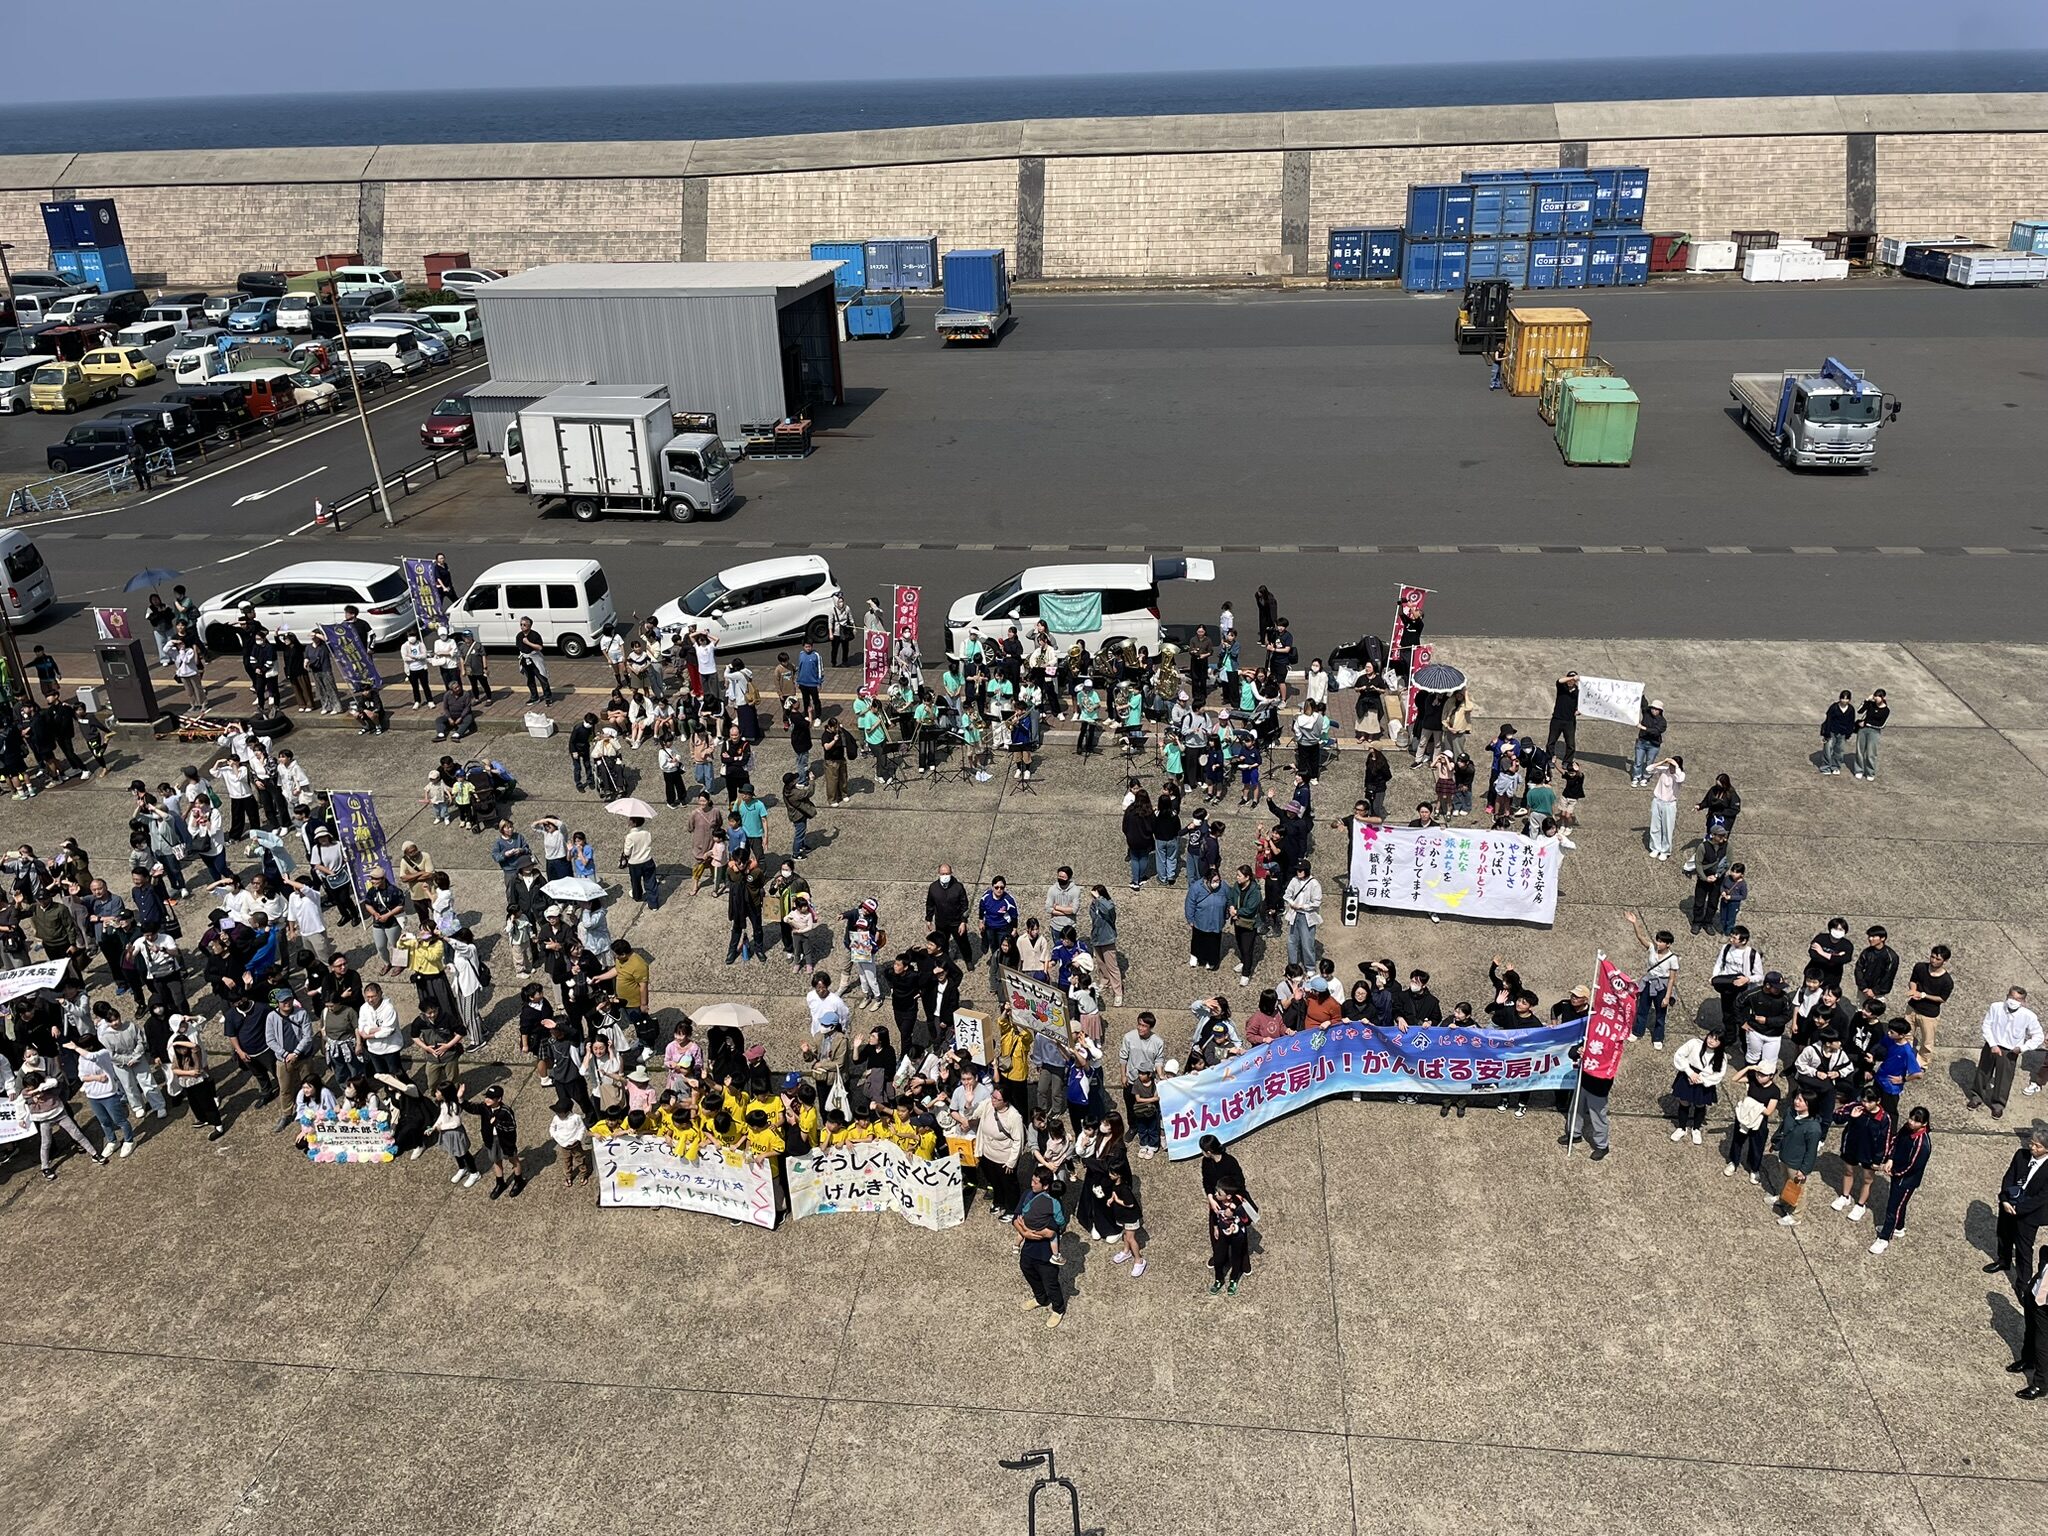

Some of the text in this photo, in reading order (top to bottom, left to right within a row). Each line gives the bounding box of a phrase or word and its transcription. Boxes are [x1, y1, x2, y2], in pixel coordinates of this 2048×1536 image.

[1367, 853, 1380, 898] 職員一同
[1381, 843, 1395, 898] 安房小学校
[1411, 835, 1427, 902] 応援してます
[1430, 838, 1441, 868] 心から
[1443, 838, 1456, 882] 旅立ちを
[1459, 839, 1471, 872] 新たな
[1477, 841, 1489, 898] ありがとう
[1491, 842, 1504, 876] いっぱい
[1506, 843, 1519, 889] やさしさ
[1521, 845, 1534, 890] 我が誇り
[1533, 847, 1546, 904] 美しき安房
[970, 1019, 981, 1044] また
[604, 1139, 623, 1203] そうし
[812, 1152, 961, 1187] そうしくん さくとくん
